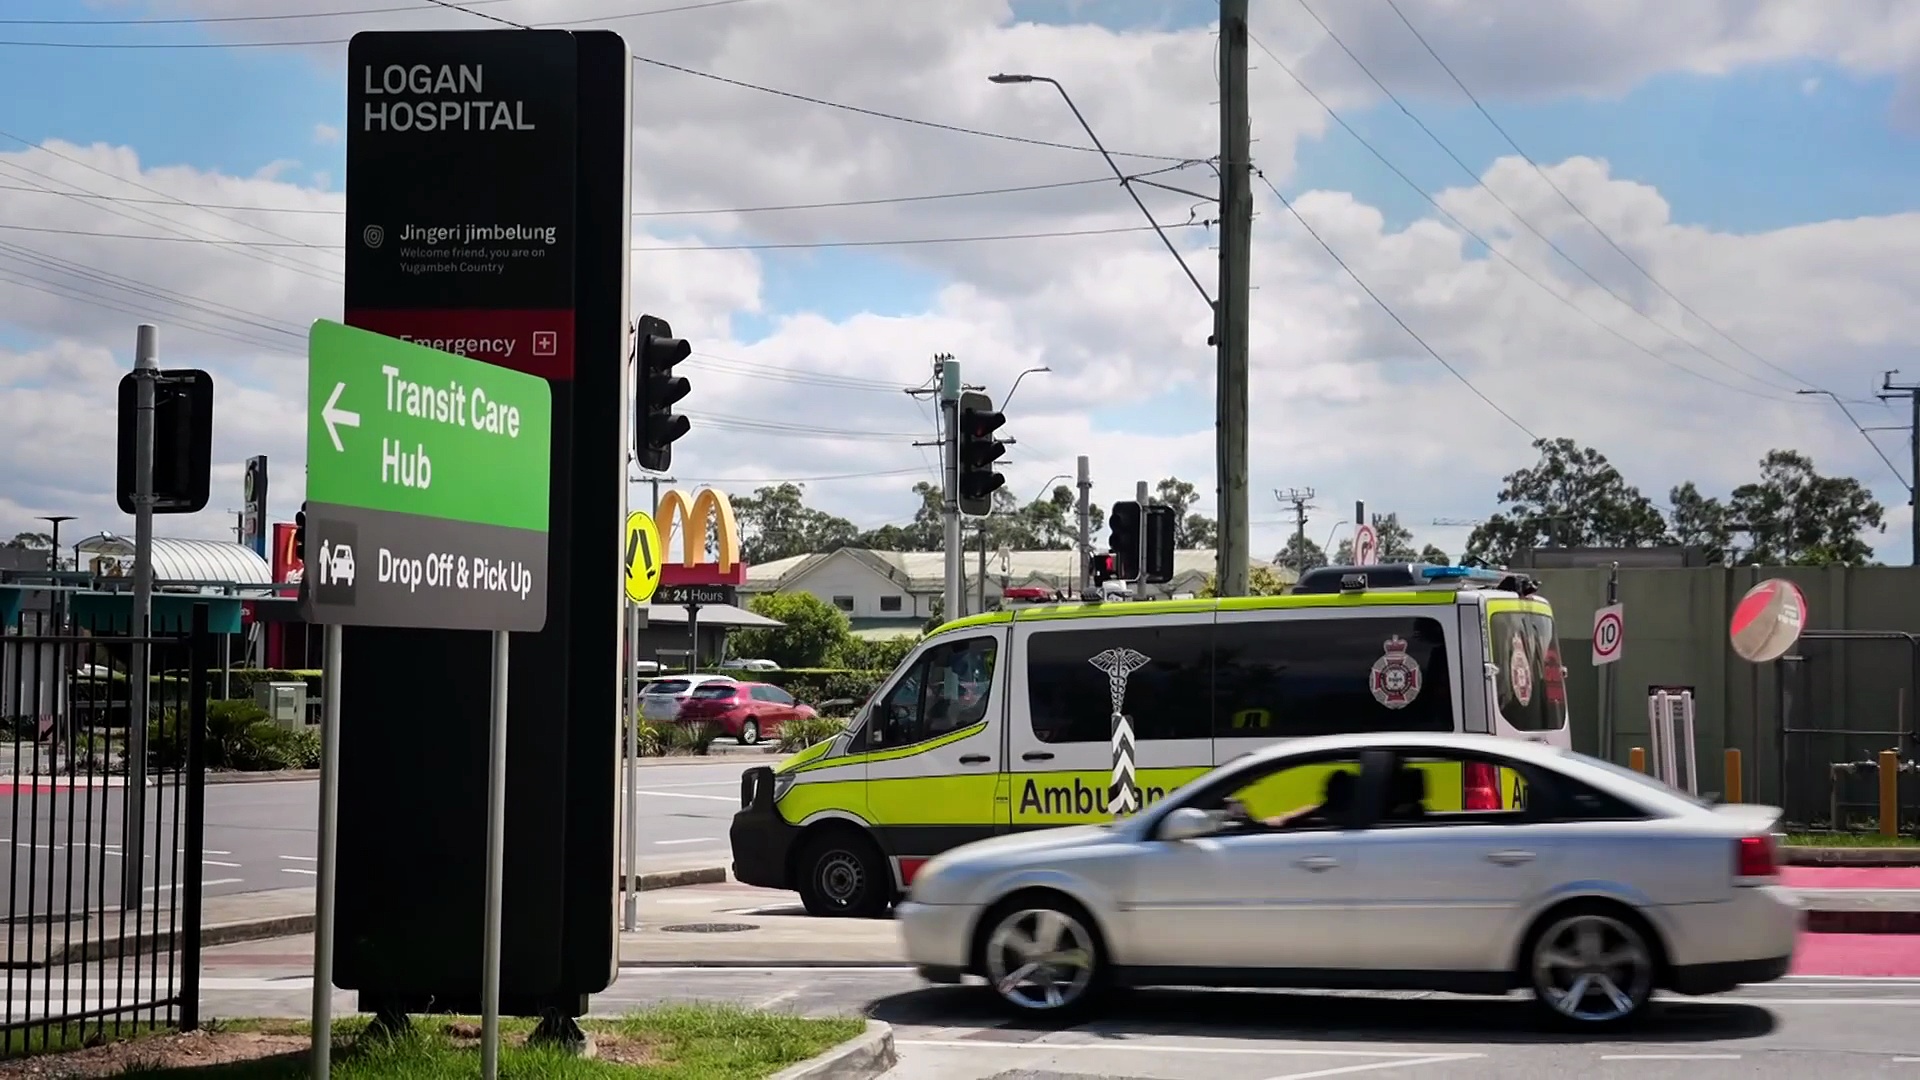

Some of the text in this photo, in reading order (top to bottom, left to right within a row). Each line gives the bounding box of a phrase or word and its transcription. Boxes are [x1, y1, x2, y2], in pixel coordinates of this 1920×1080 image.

[365, 64, 483, 94] LOGAN
[364, 101, 536, 132] HOSPITAL
[400, 224, 557, 245] Jingeri jimbelung
[400, 247, 546, 260] Welcome friend, you are on
[400, 262, 505, 275] Yugambeh Country
[400, 335, 517, 357] mergency
[382, 364, 520, 439] Transit Care
[382, 437, 432, 490] Hub
[378, 548, 532, 601] Drop Off & Pick Up
[673, 589, 724, 601] 24 Hours
[1601, 623, 1616, 646] 10
